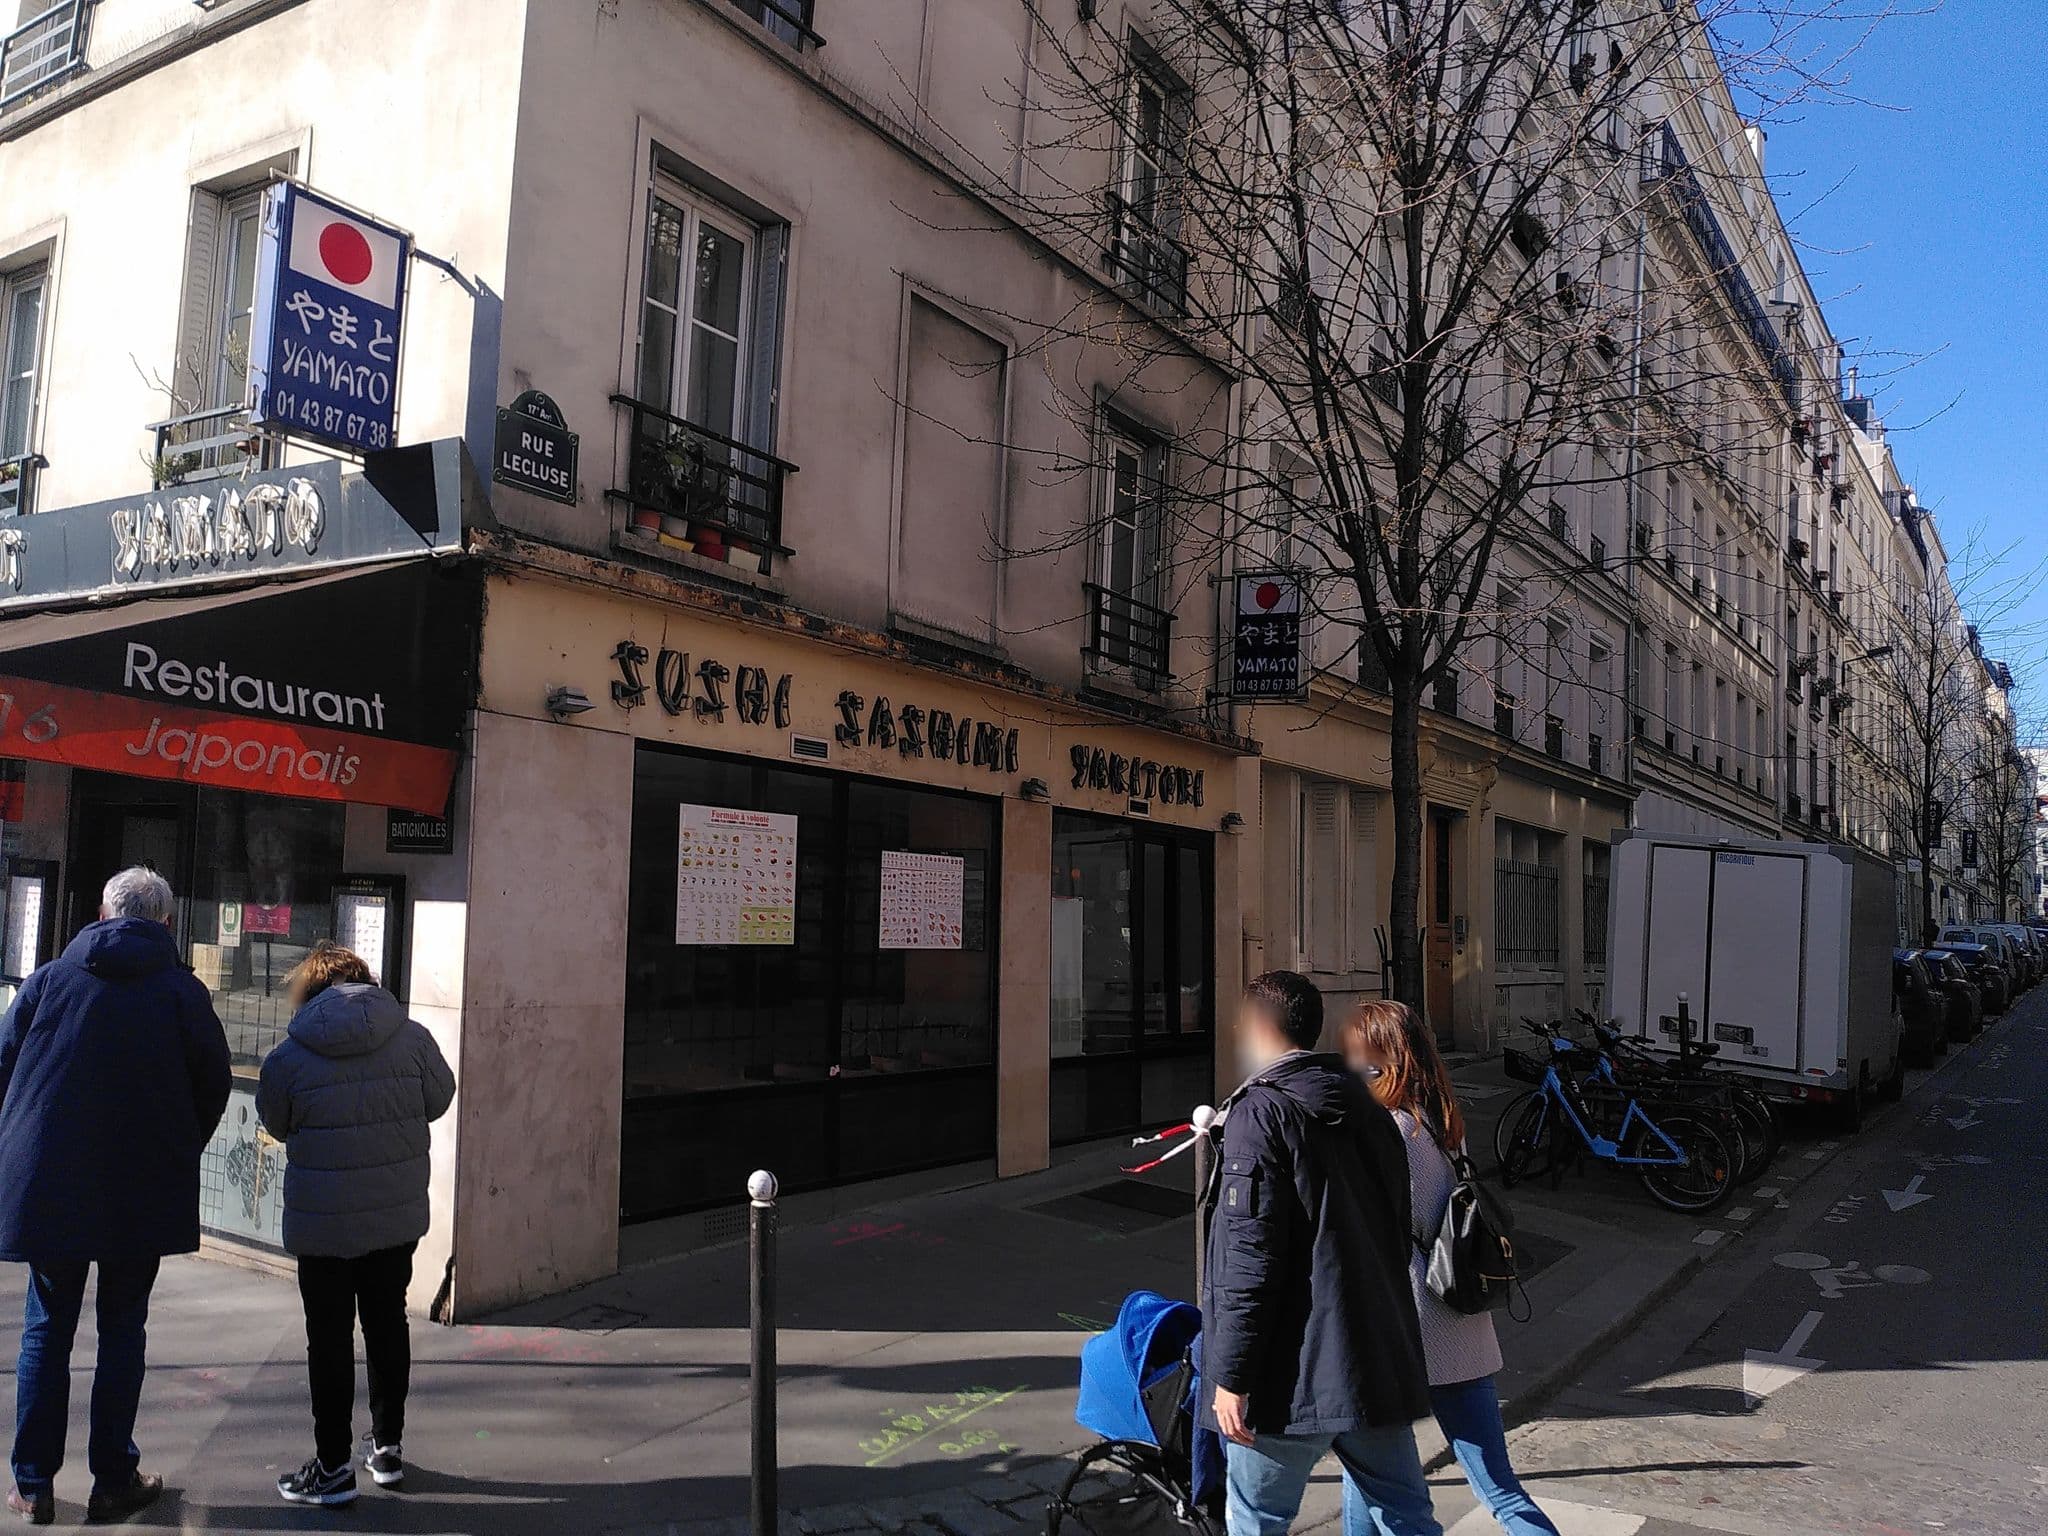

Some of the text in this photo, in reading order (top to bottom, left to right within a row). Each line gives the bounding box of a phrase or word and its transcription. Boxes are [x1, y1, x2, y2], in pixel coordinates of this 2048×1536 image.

[285, 289, 393, 362] やまと
[282, 338, 389, 405] YAMATO
[277, 390, 387, 448] 01 43 87 67 38
[522, 431, 554, 458] RUE
[503, 451, 569, 488] LECLUSE
[123, 642, 385, 731] Restaurant
[1236, 679, 1296, 691] 01 43 87 67 38
[1237, 657, 1297, 673] YAMATO
[610, 640, 1204, 808] SUSHI SASHIMI YAKITORI
[391, 822, 447, 838] BATIGNOLLES
